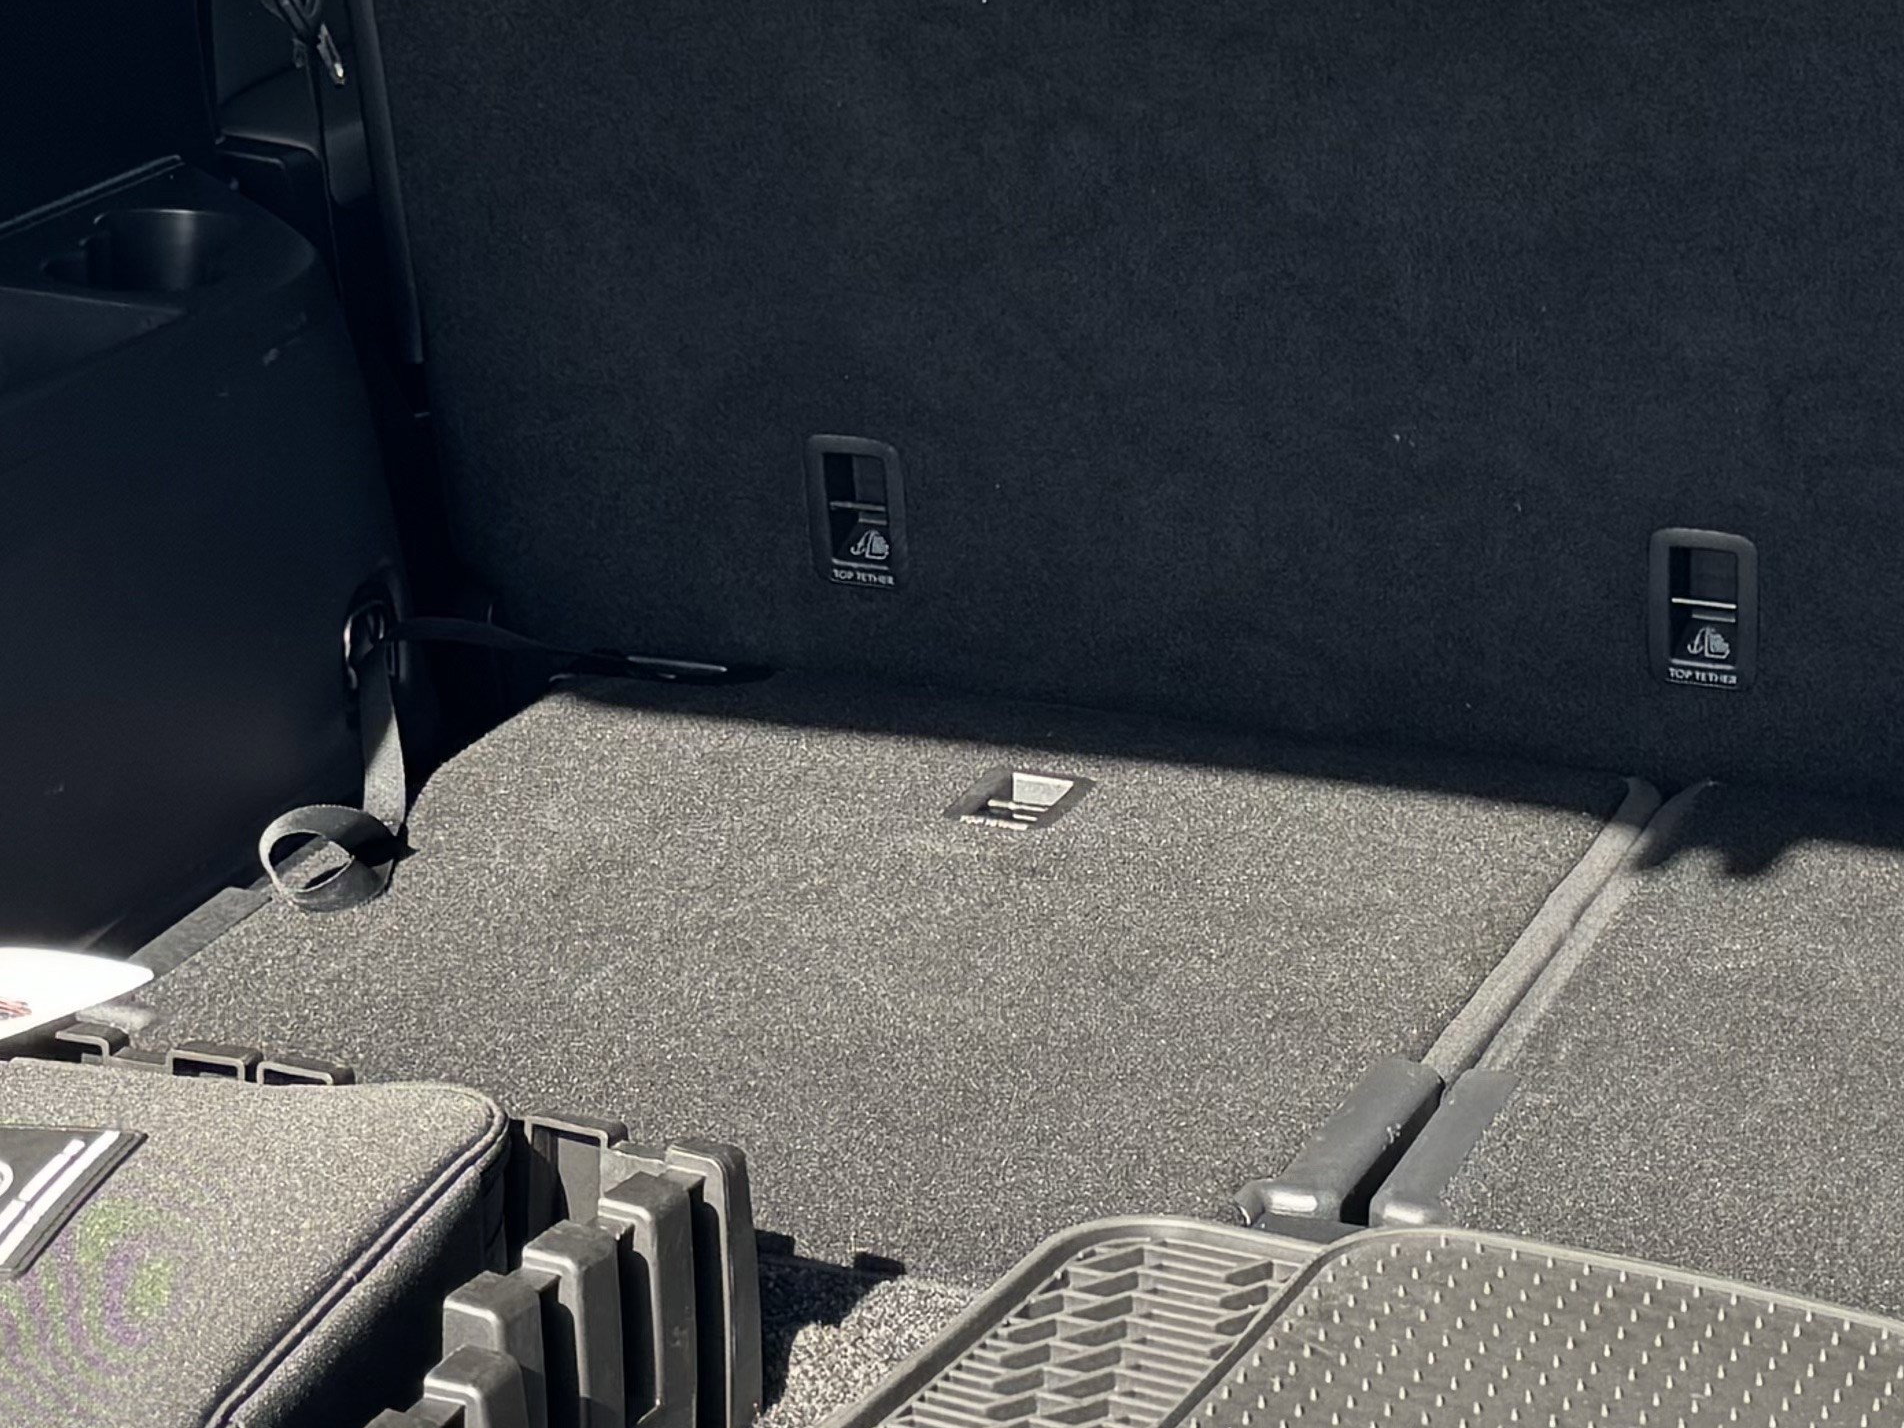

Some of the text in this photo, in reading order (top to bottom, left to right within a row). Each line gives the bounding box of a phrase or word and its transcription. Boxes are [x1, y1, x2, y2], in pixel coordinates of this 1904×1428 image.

[832, 569, 895, 585] TOP TETHER
[1669, 667, 1737, 684] TOP TETHER
